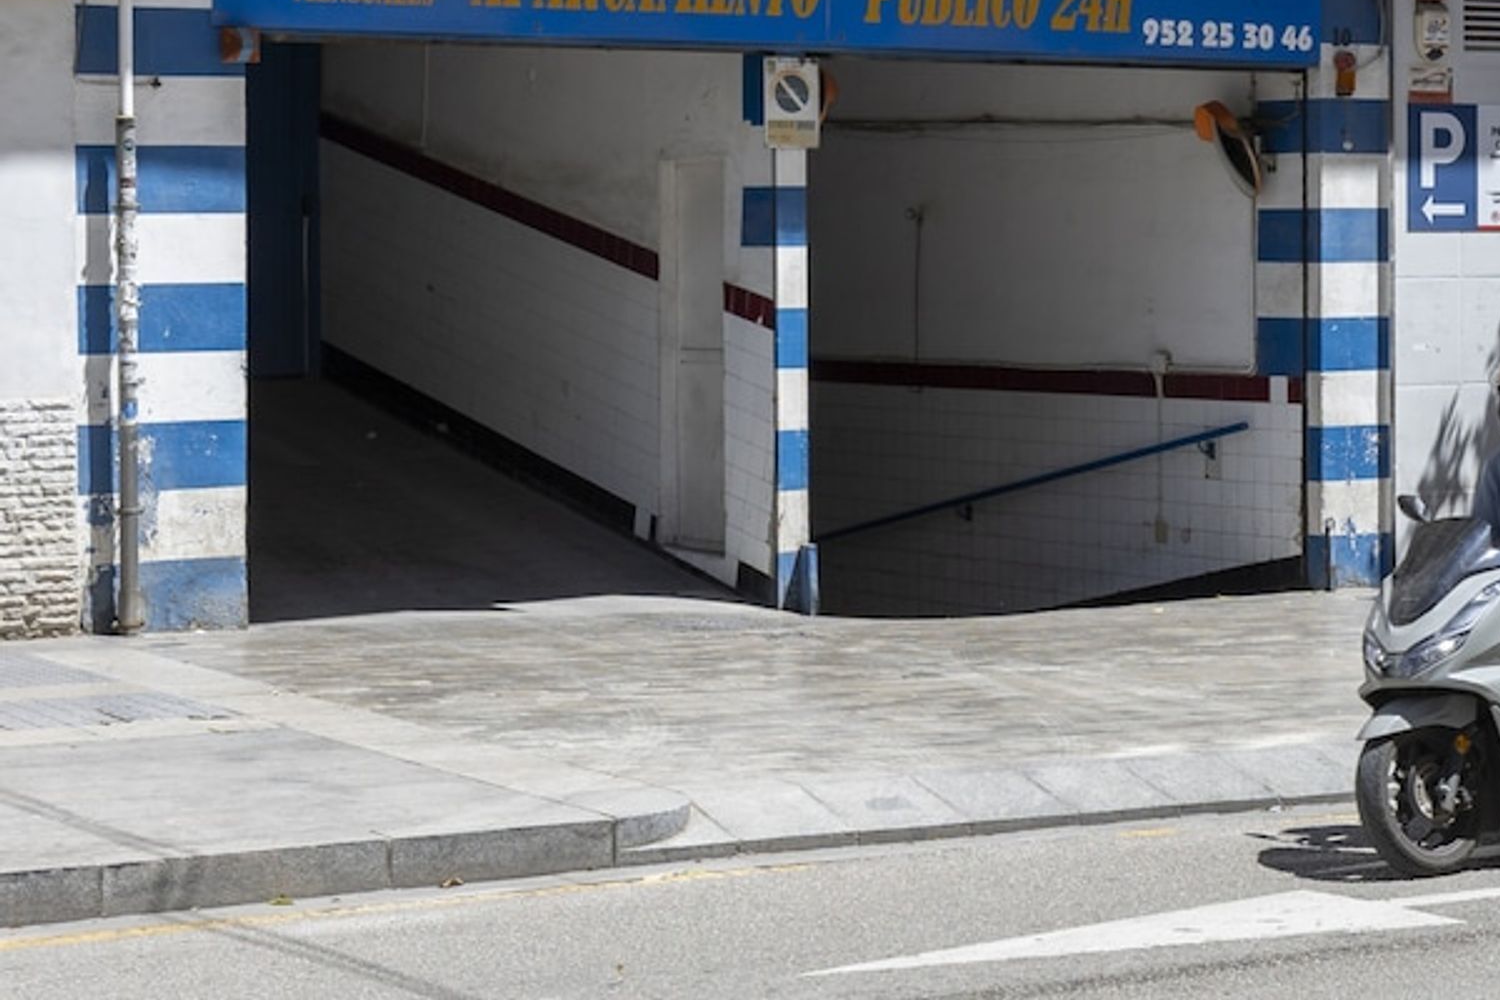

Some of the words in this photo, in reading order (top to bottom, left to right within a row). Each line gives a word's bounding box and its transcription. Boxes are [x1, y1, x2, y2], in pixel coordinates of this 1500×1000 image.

[1142, 17, 1194, 48] 952
[1202, 20, 1235, 49] 25
[1243, 22, 1275, 51] 30
[1281, 24, 1314, 52] 46
[1419, 110, 1466, 190] P
